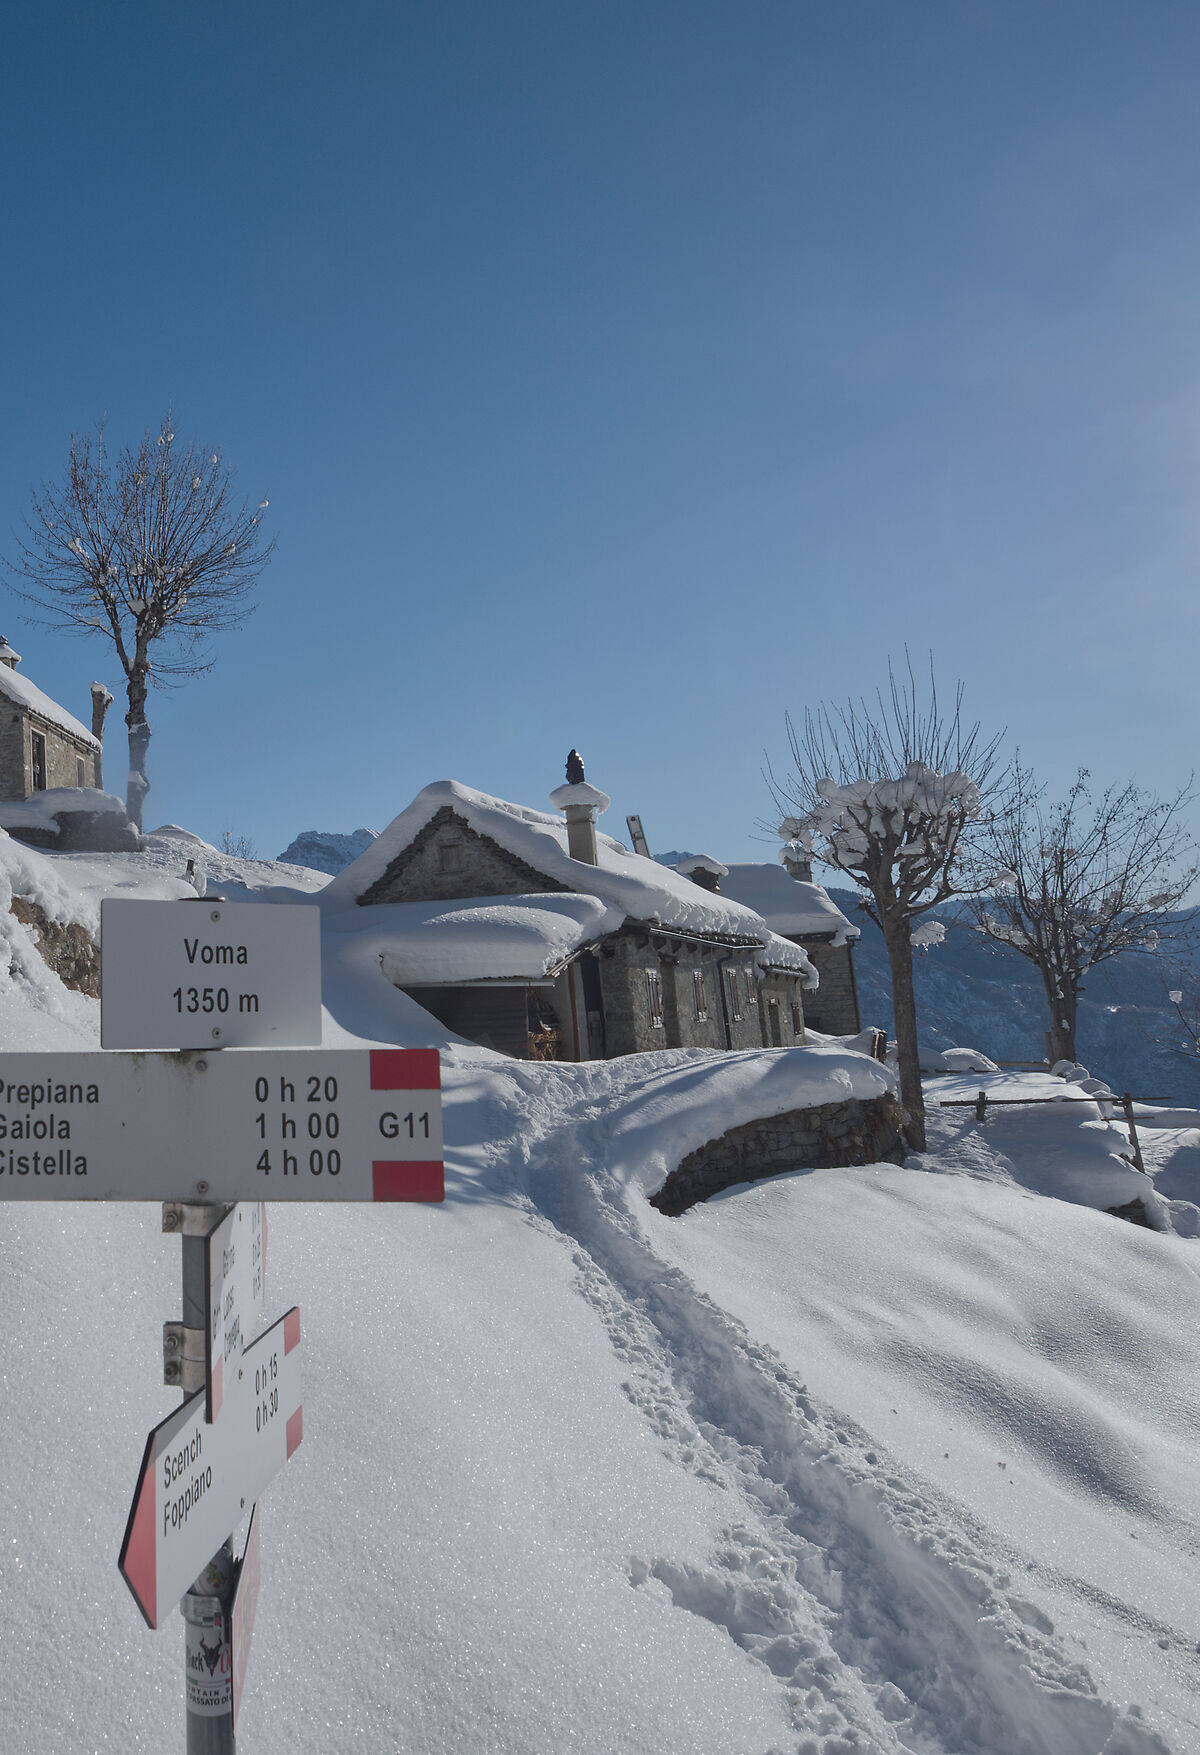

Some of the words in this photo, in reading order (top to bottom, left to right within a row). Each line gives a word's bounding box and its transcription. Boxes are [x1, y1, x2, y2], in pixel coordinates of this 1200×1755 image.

[183, 937, 249, 965] Voma
[172, 986, 230, 1013] 1350
[238, 992, 260, 1013] m
[254, 1076, 270, 1103] 0
[279, 1076, 296, 1103] h
[306, 1076, 339, 1102] 20
[255, 1112, 267, 1139] 1
[281, 1112, 297, 1139] h
[307, 1112, 340, 1139] 00
[378, 1111, 431, 1139] G11
[256, 1149, 272, 1176] 4
[283, 1149, 299, 1176] h
[308, 1149, 342, 1176] 00
[255, 1369, 260, 1396] 0
[262, 1364, 267, 1389] h
[270, 1352, 278, 1381] 15
[256, 1405, 261, 1433] 0
[262, 1400, 268, 1426] h
[270, 1387, 279, 1418] 30
[164, 1426, 202, 1489] Scench
[164, 1465, 212, 1537] Foppiano
